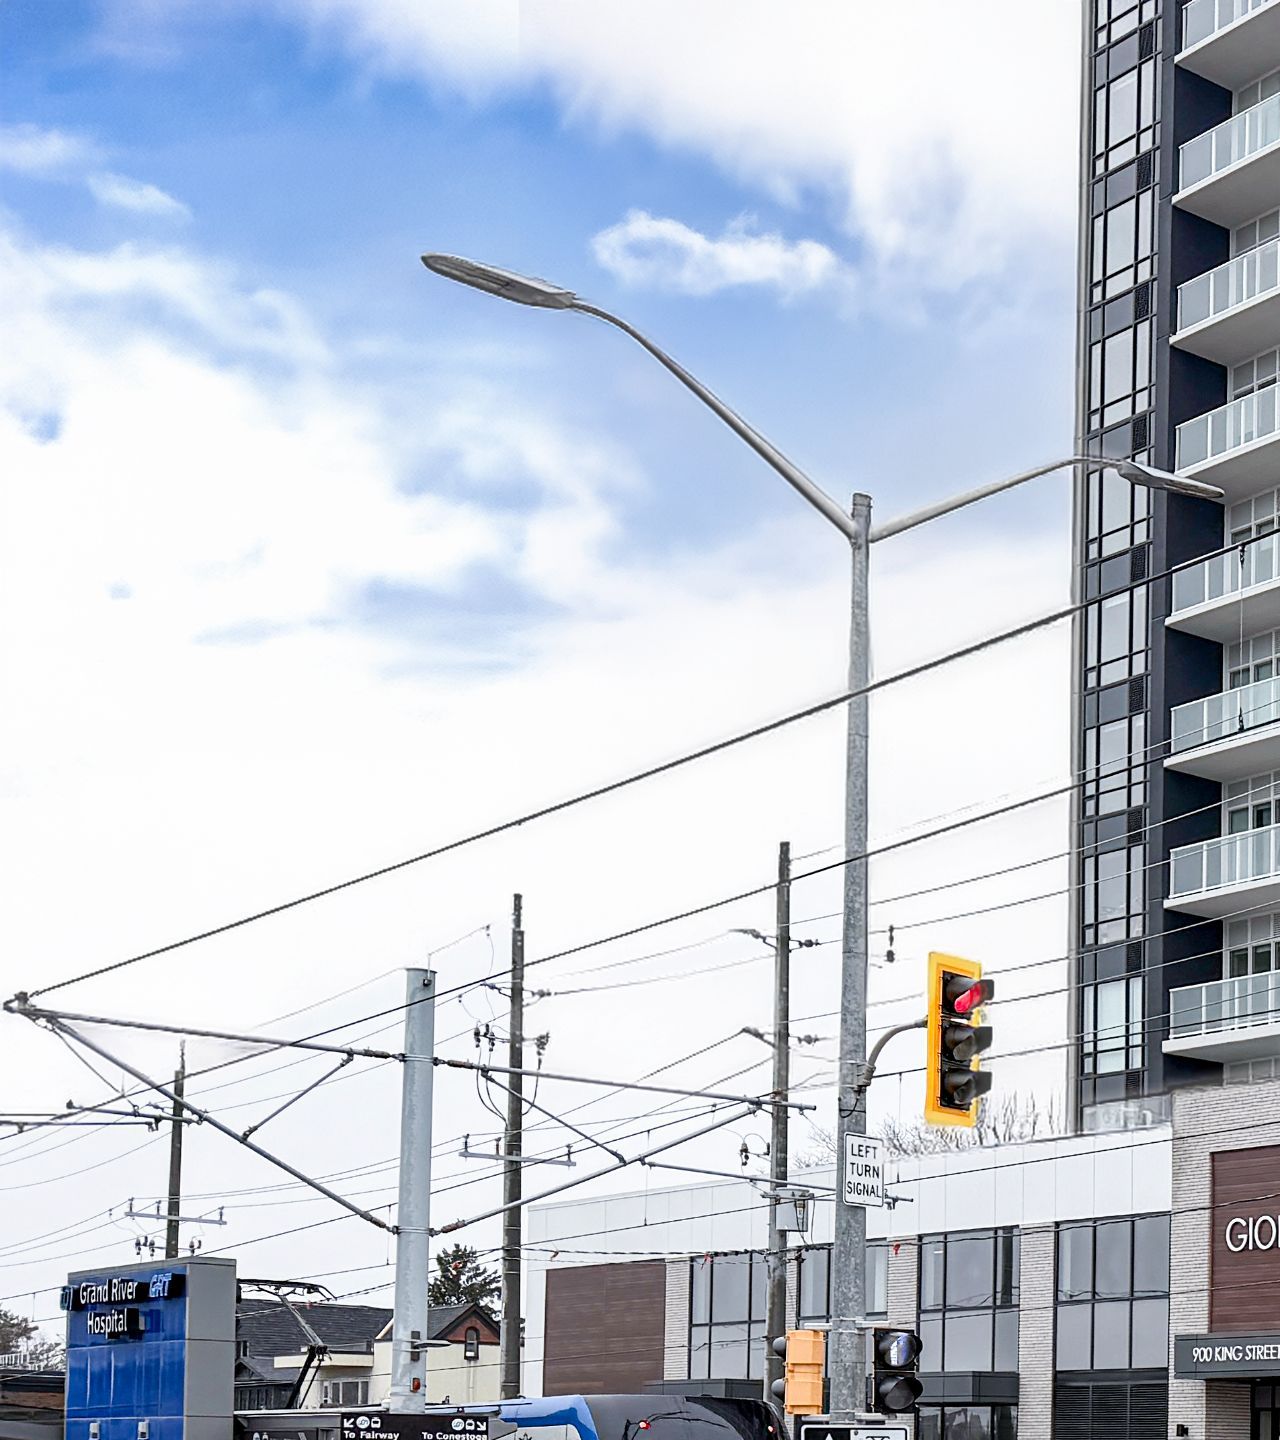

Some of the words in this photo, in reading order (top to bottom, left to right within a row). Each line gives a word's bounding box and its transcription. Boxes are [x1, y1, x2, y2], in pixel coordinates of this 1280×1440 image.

[851, 1143, 877, 1159] LEFT
[850, 1162, 879, 1179] TURN
[847, 1181, 882, 1199] SIGNAL
[80, 1279, 109, 1304] Grand
[111, 1277, 138, 1301] River
[87, 1308, 127, 1339] Hospital
[1192, 1347, 1213, 1363] 900
[1214, 1345, 1243, 1362] KING
[343, 1430, 355, 1439] To
[422, 1431, 433, 1440] To
